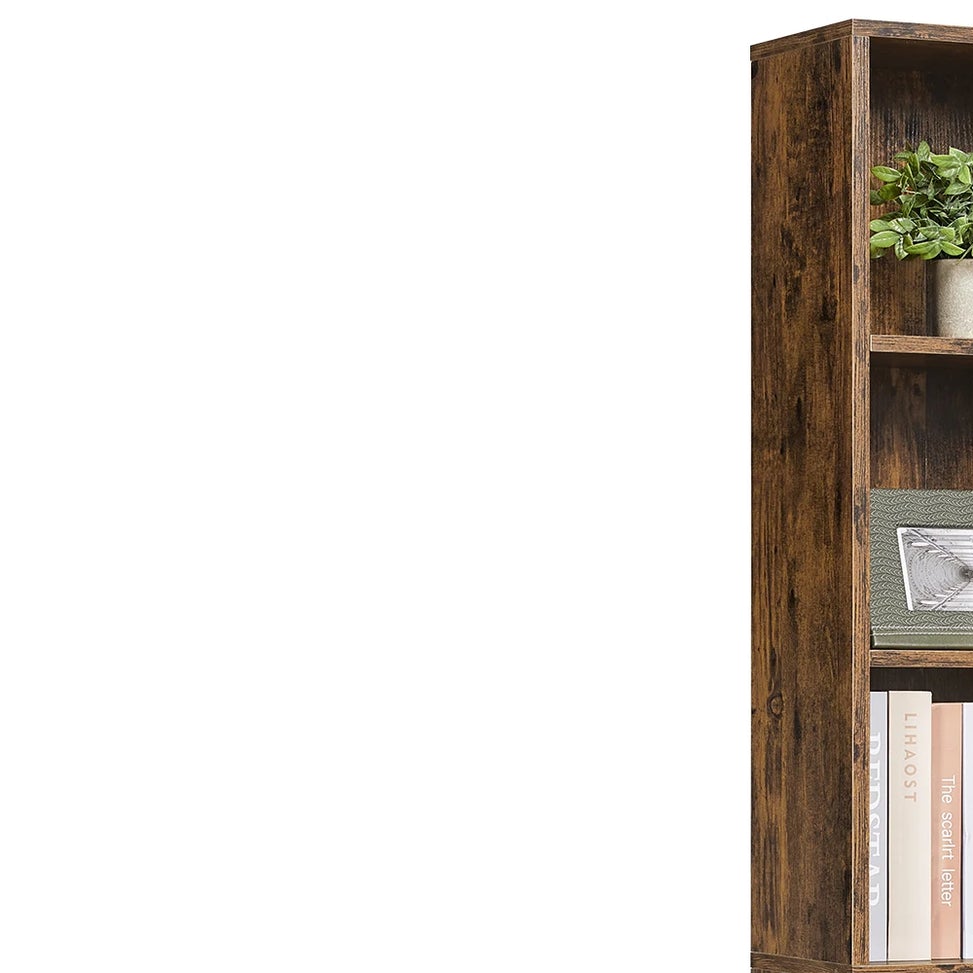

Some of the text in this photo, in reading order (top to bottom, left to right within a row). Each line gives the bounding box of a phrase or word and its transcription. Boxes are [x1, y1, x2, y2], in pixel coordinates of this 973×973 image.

[904, 712, 917, 802] LIHAOST
[941, 775, 955, 804] The
[941, 869, 955, 908] letter
